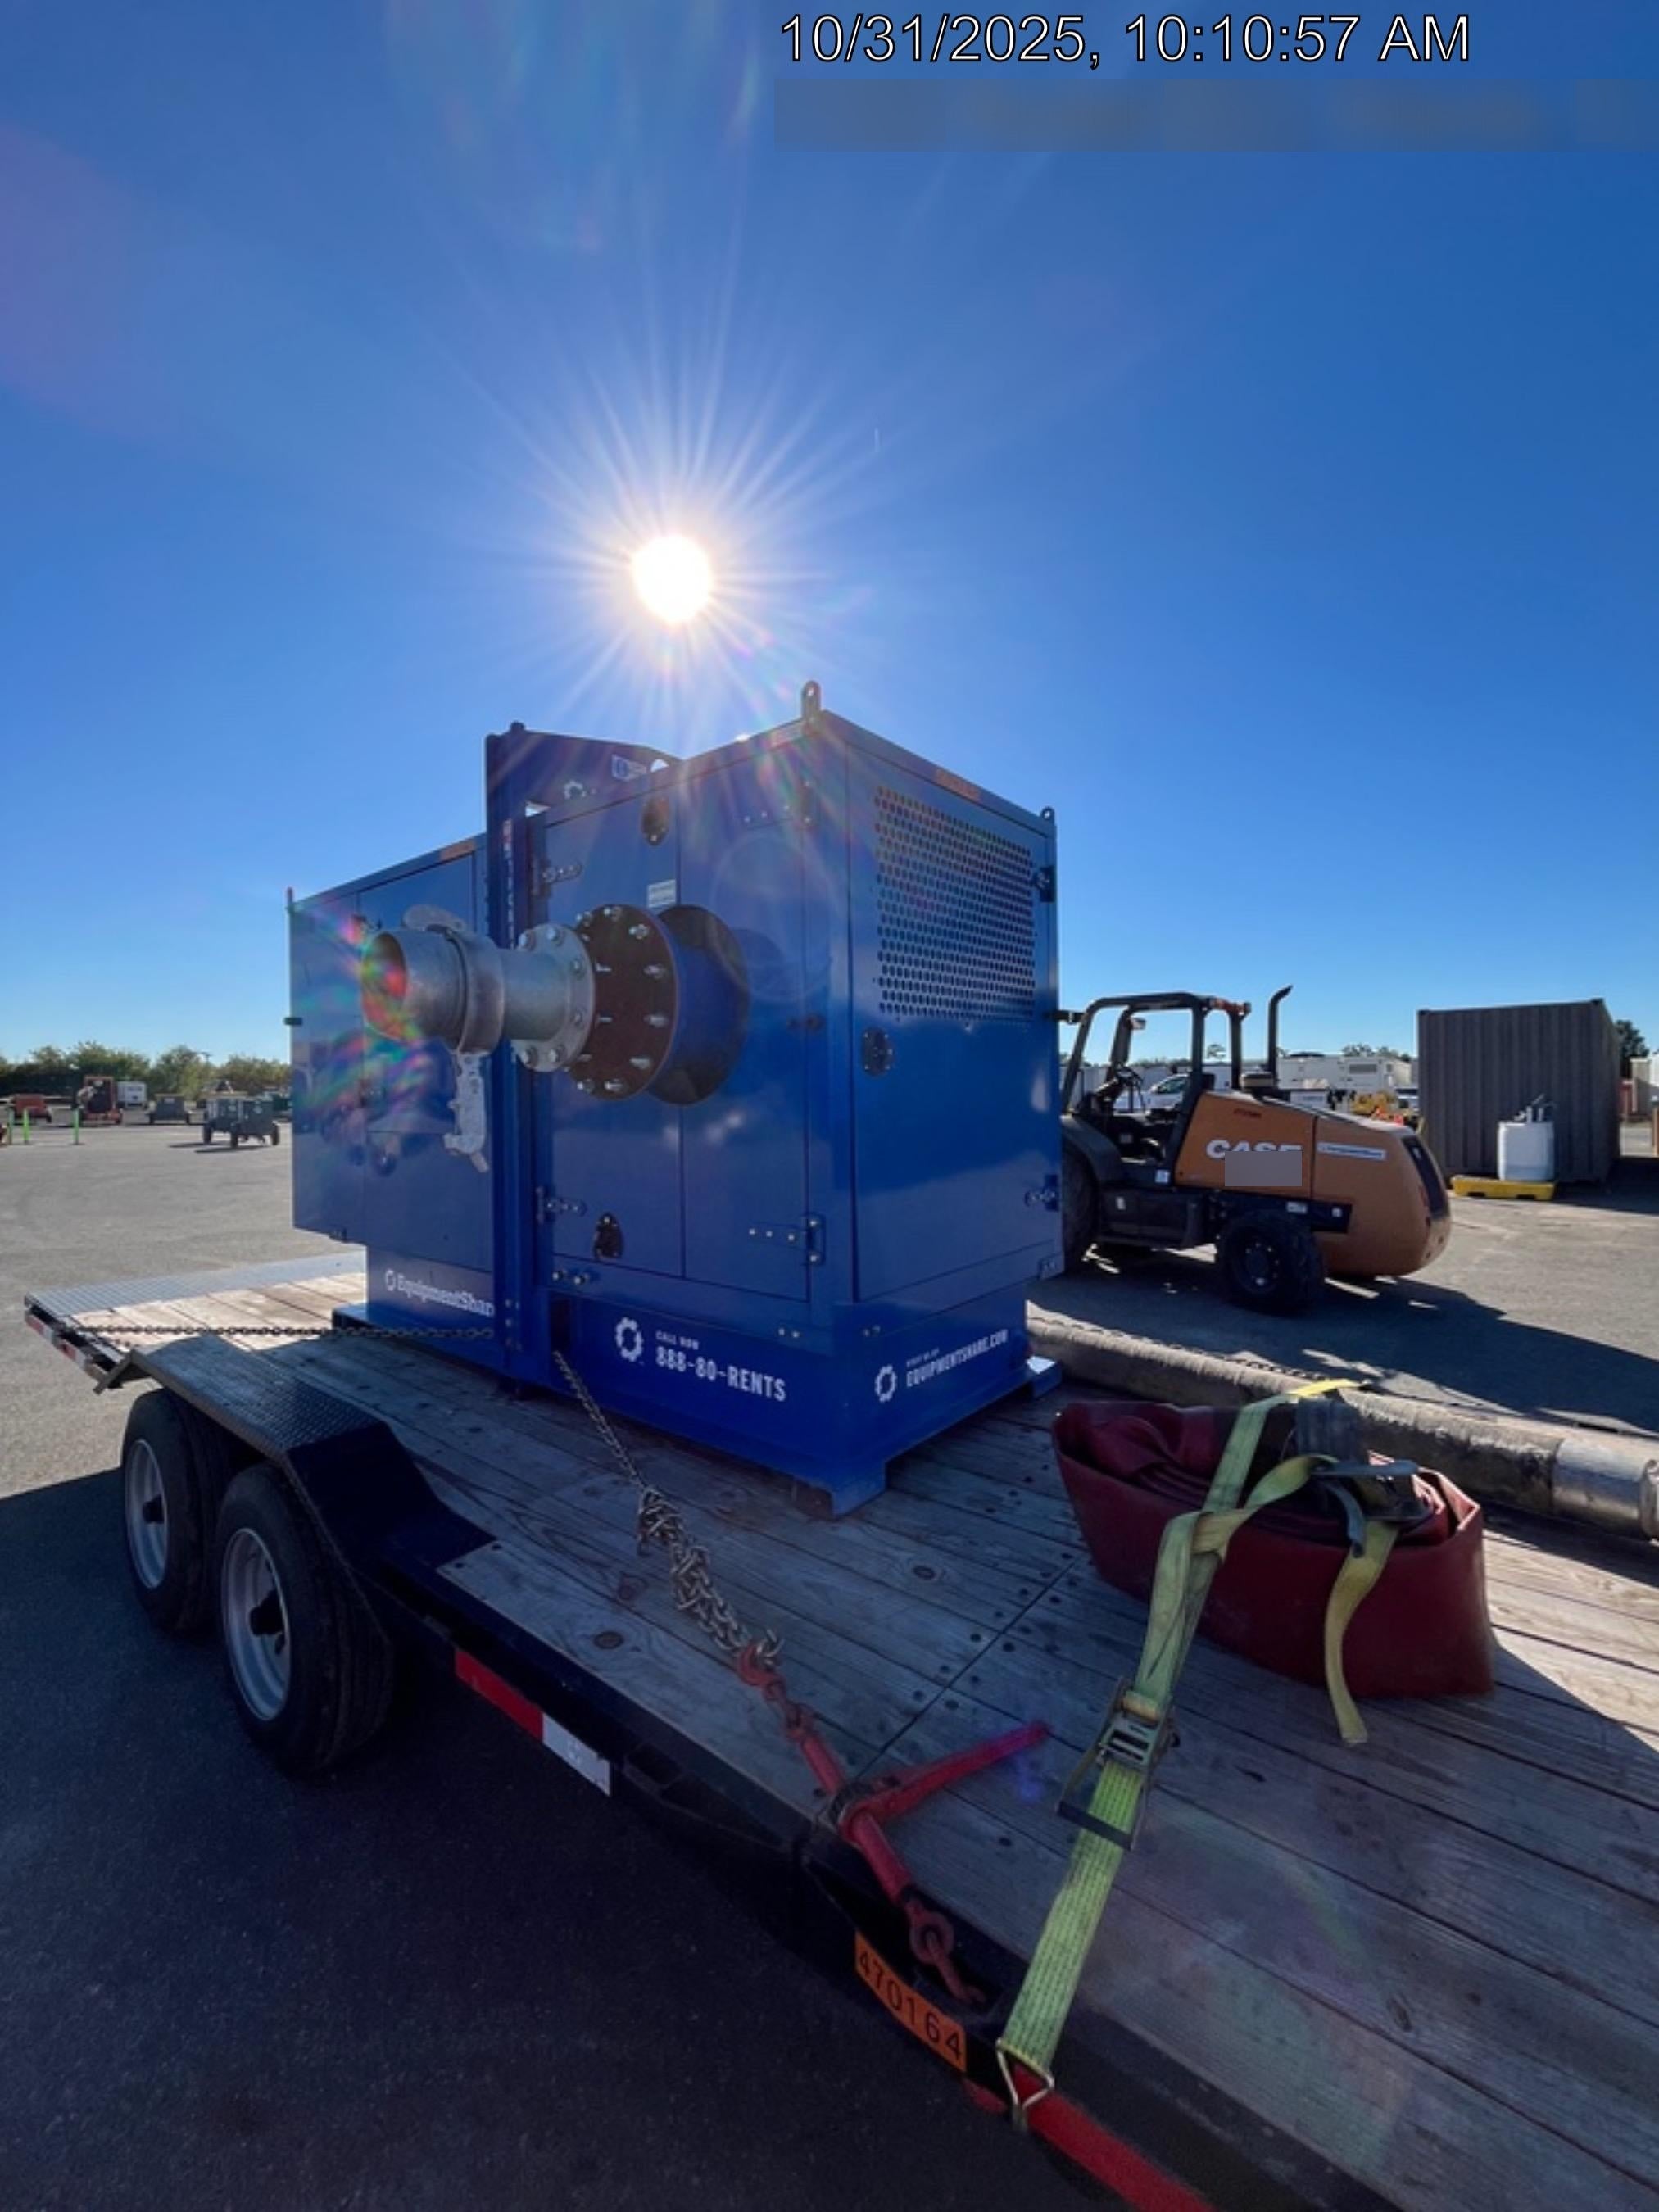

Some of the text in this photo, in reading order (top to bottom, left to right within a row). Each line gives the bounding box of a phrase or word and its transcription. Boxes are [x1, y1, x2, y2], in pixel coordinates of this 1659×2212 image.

[397, 1273, 495, 1317] EquipmentShar
[656, 1346, 787, 1402] 888-80-RENTS
[860, 1951, 963, 2060] 470164
